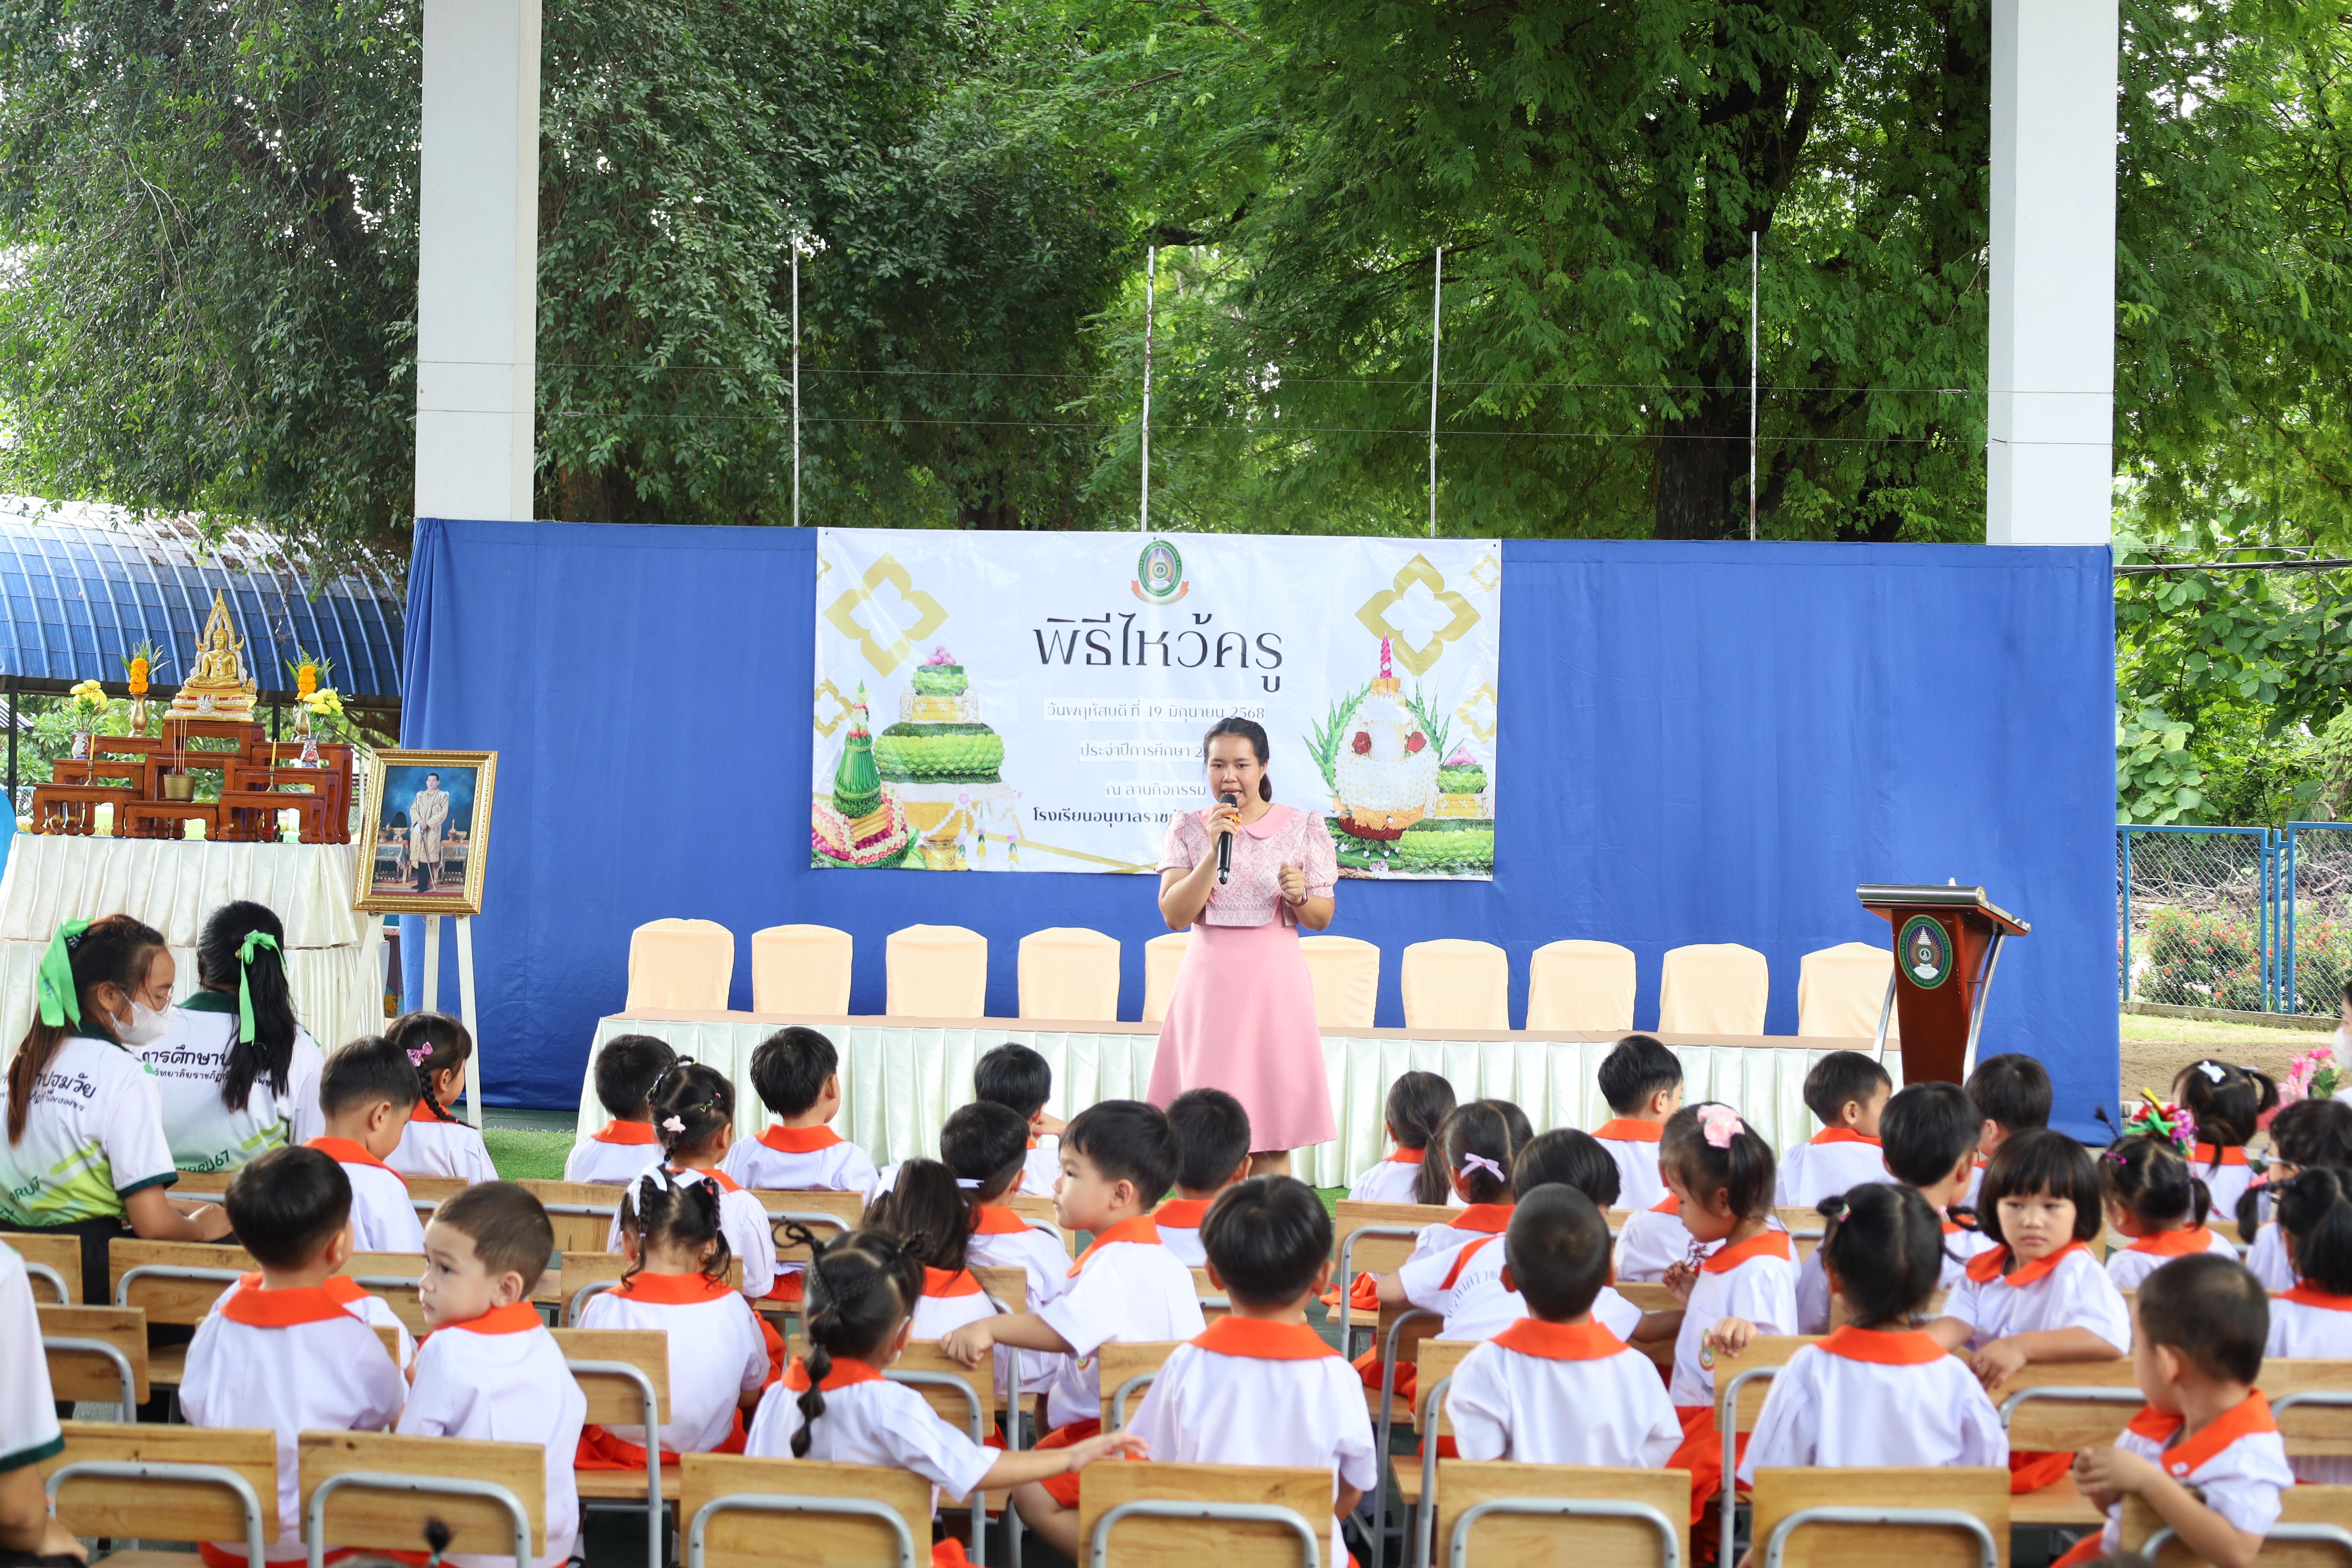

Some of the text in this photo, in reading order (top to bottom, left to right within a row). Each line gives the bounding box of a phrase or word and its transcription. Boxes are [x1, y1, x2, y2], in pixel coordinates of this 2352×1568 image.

[1033, 612, 1282, 692] พิธีไหว้ครู
[1148, 706, 1162, 717] 19
[1168, 704, 1224, 723] มิถุนายน
[1230, 707, 1265, 719] 2568
[1081, 742, 1189, 758] ประจำปีการศึกษา
[1106, 783, 1206, 796] ณ ลานกิจกรรม
[1033, 807, 1172, 827] โรงเรียนอนุบาลราช
[142, 1044, 233, 1066] การศึกษาป
